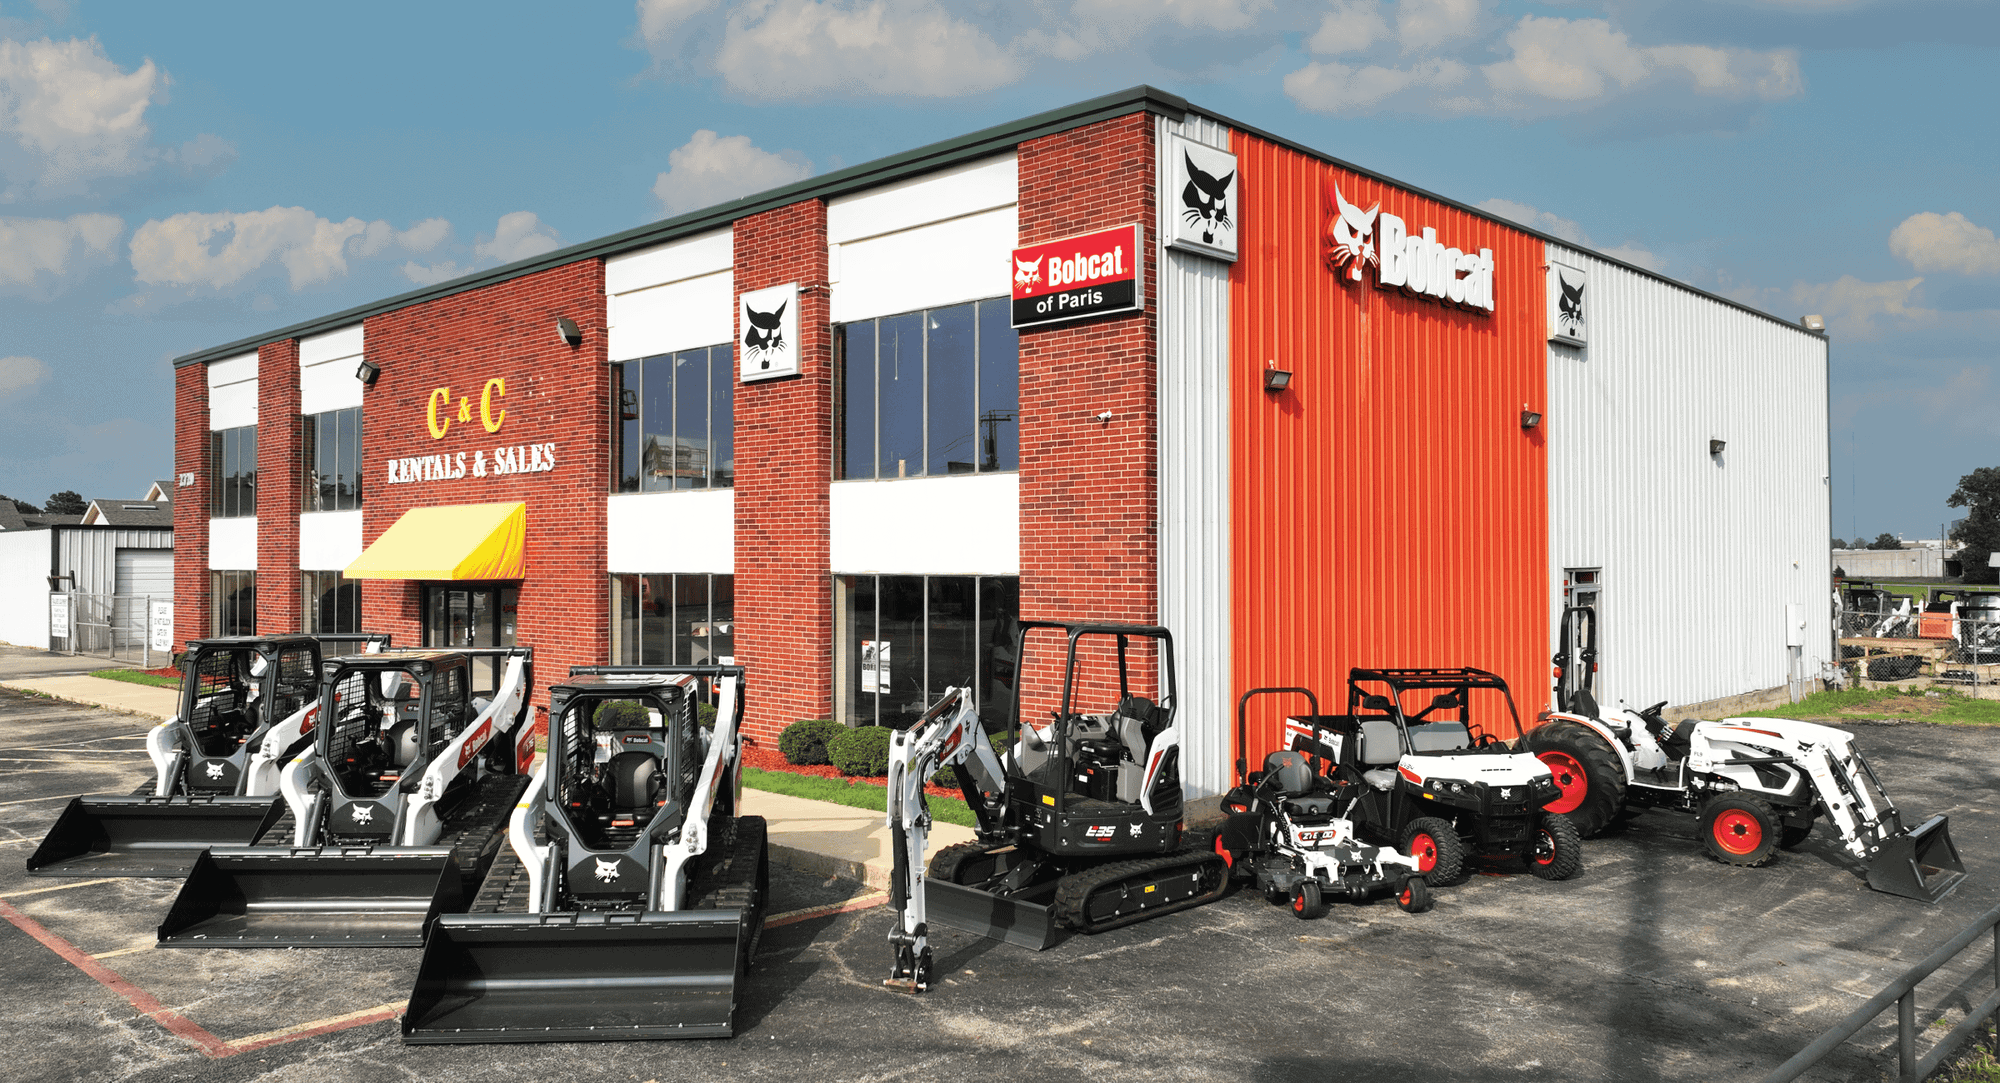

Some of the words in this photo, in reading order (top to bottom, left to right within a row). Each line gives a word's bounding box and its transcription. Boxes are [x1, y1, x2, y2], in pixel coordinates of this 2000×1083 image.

[1048, 245, 1122, 287] Bobcat
[1379, 212, 1495, 312] Bobcat
[1036, 296, 1054, 313] of
[1059, 289, 1103, 310] Paris
[427, 387, 450, 439] C
[458, 396, 473, 423] &
[480, 377, 506, 433] C
[387, 451, 467, 484] RENTALS
[473, 450, 487, 478] &
[494, 442, 556, 475] SALES
[1085, 825, 1117, 837] E35
